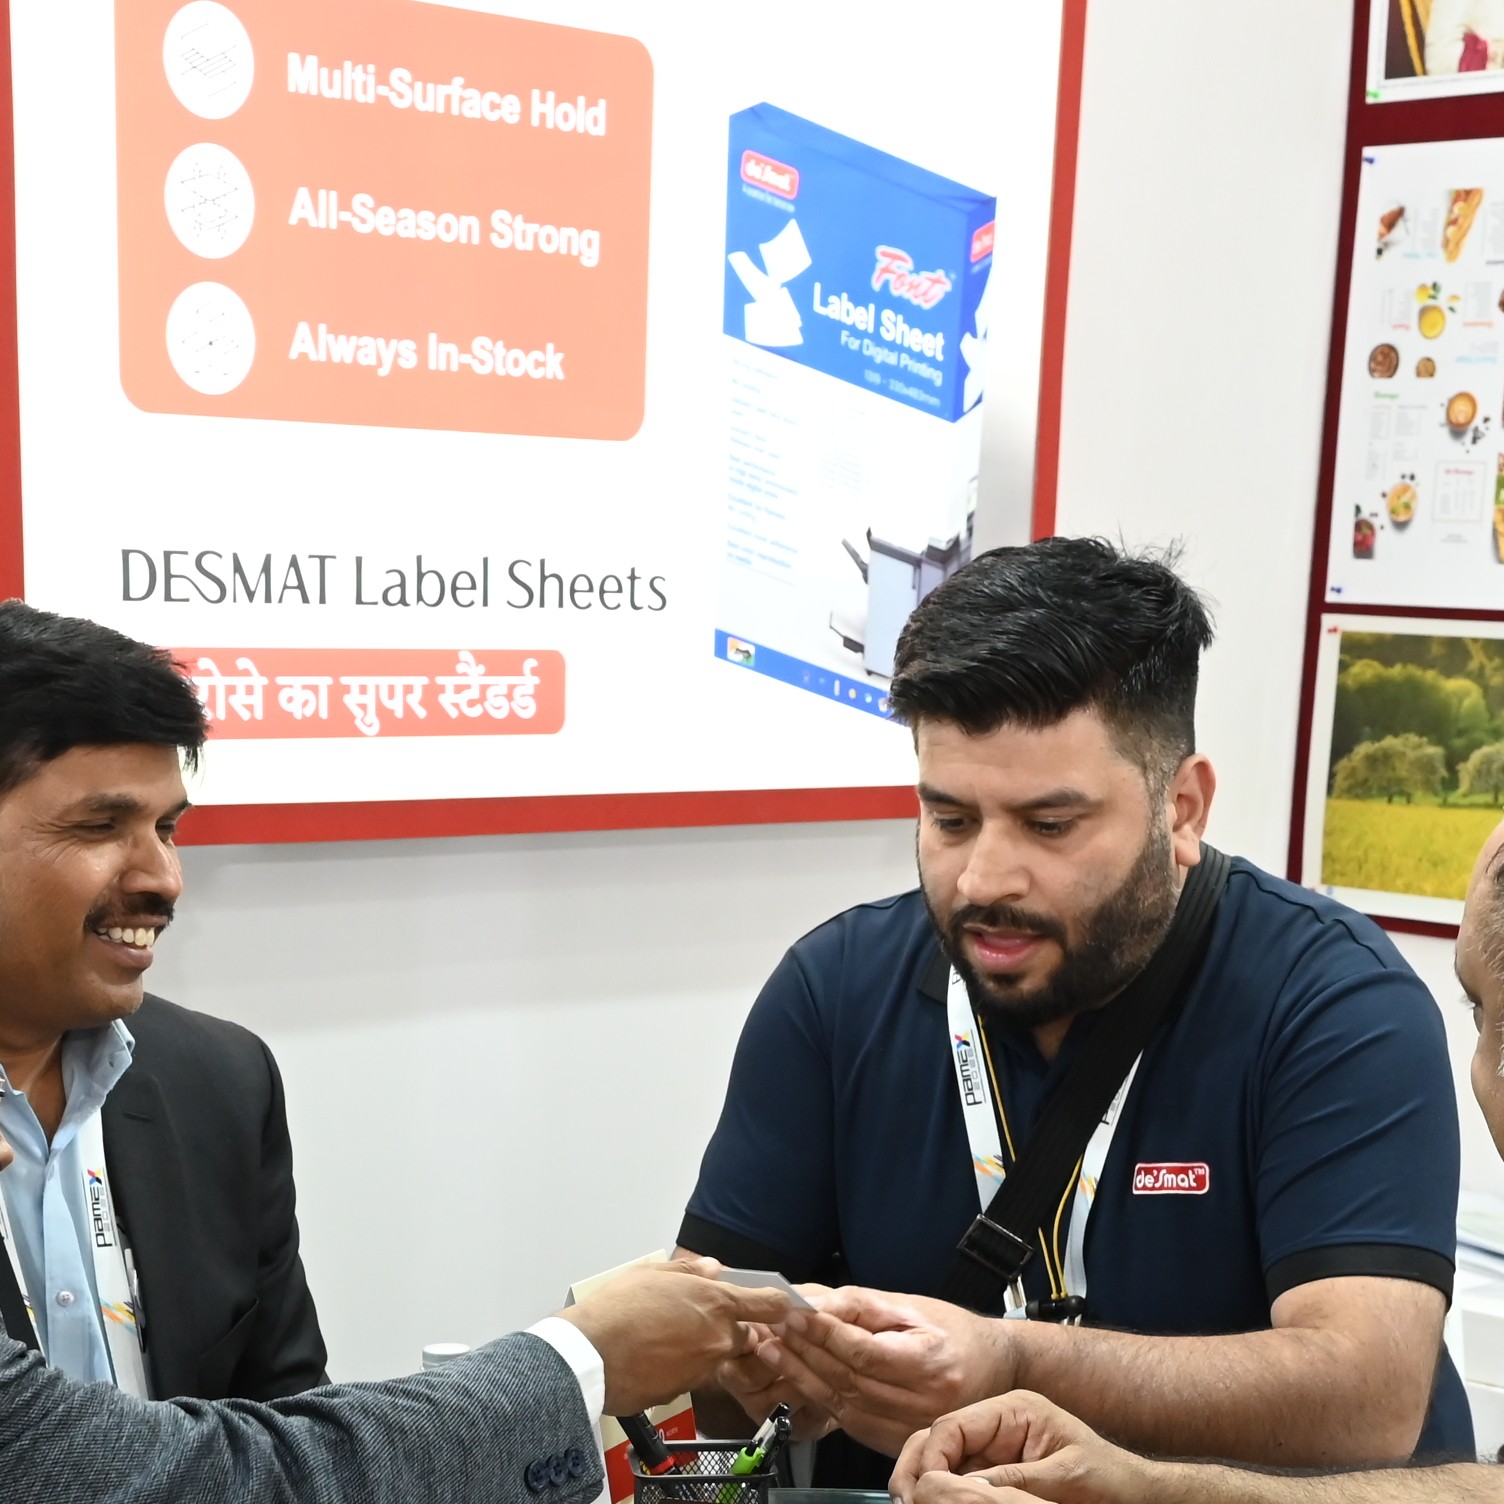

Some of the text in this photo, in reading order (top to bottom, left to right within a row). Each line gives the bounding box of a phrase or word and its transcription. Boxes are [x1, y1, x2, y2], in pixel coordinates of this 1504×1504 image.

[287, 51, 606, 137] Multi-Surface Hold
[288, 186, 600, 267] All-Season Strong
[288, 320, 565, 381] Always In-Stock
[813, 281, 945, 362] Label Sheet
[840, 330, 860, 351] For
[862, 338, 898, 365] Digital
[899, 352, 943, 387] Printing
[120, 548, 667, 612] DESMAT Label Sheets
[276, 675, 332, 720] का
[340, 675, 429, 736] सुपर
